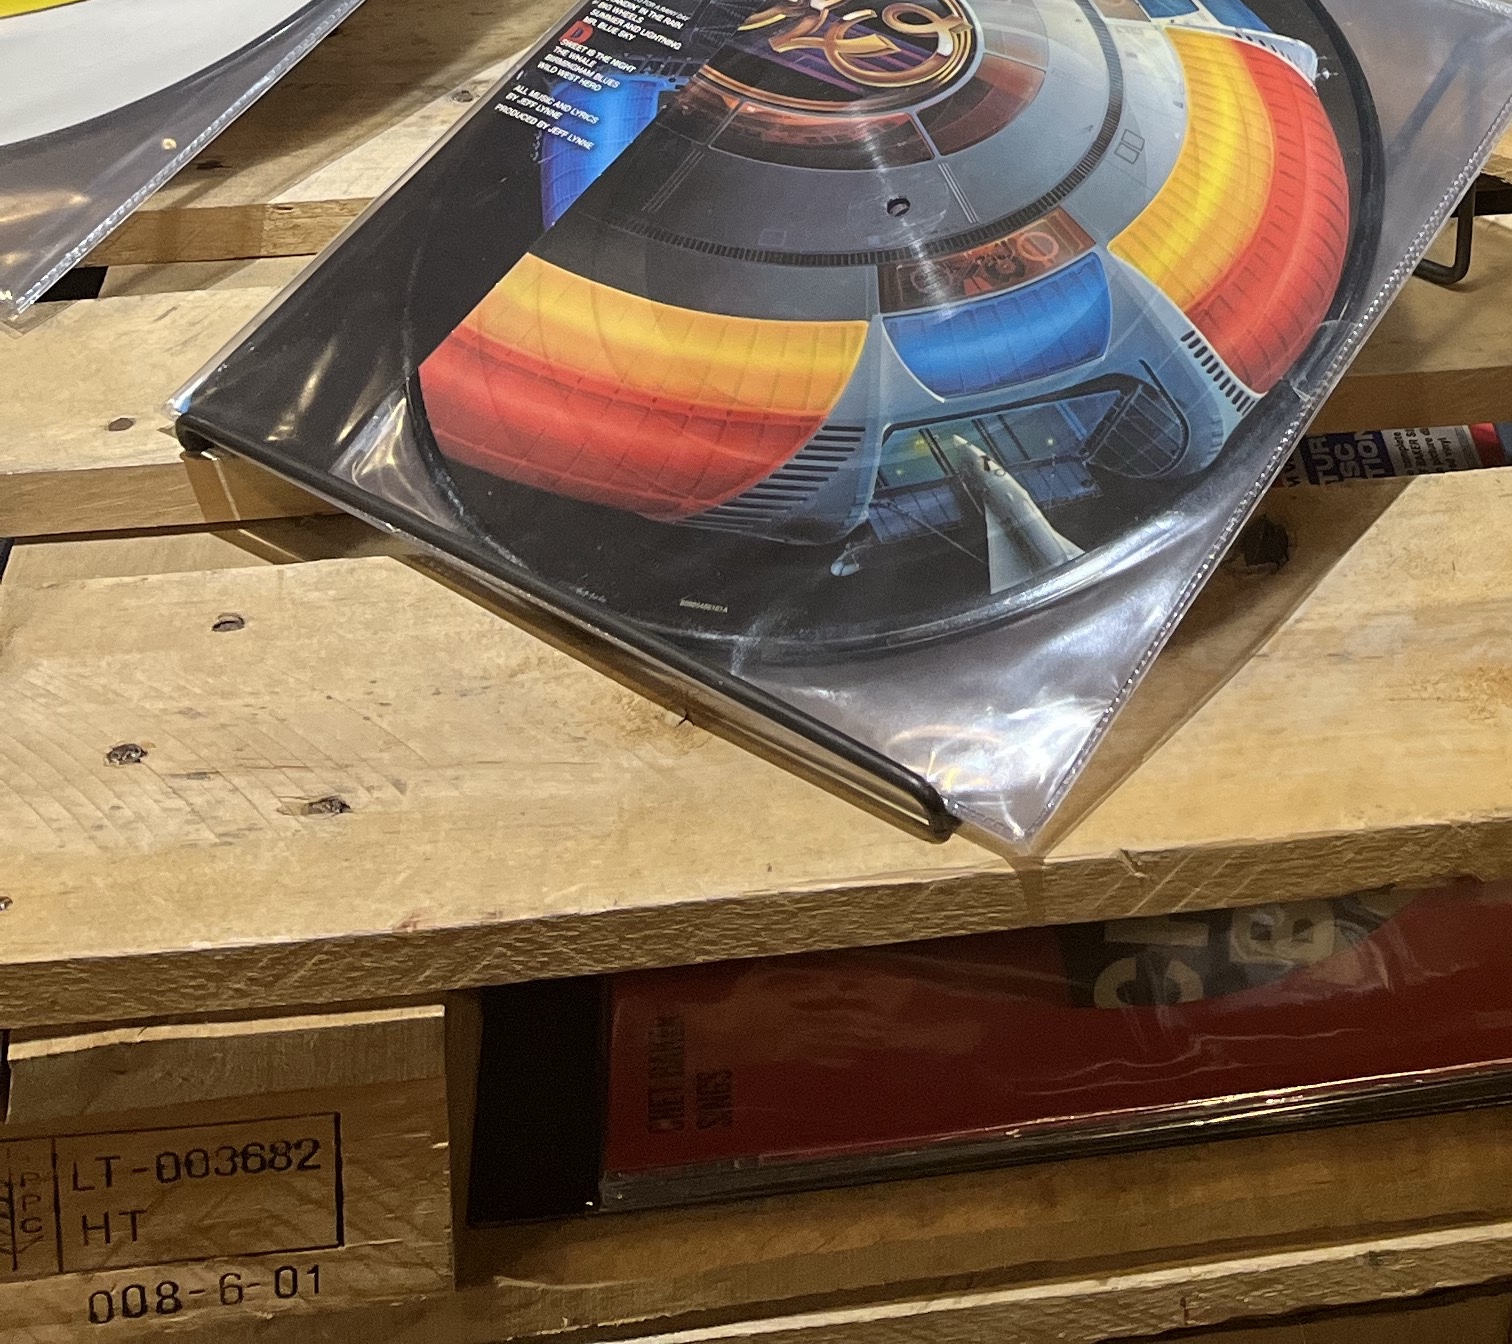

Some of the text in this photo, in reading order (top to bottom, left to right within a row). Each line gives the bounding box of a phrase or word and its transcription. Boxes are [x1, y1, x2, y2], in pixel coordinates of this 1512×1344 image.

[494, 103, 595, 150] PRODUCED BY JEFF LYNNE
[72, 1138, 321, 1193] LT-003682
[81, 1209, 148, 1246] HT
[88, 1264, 321, 1325] 008-6-01
